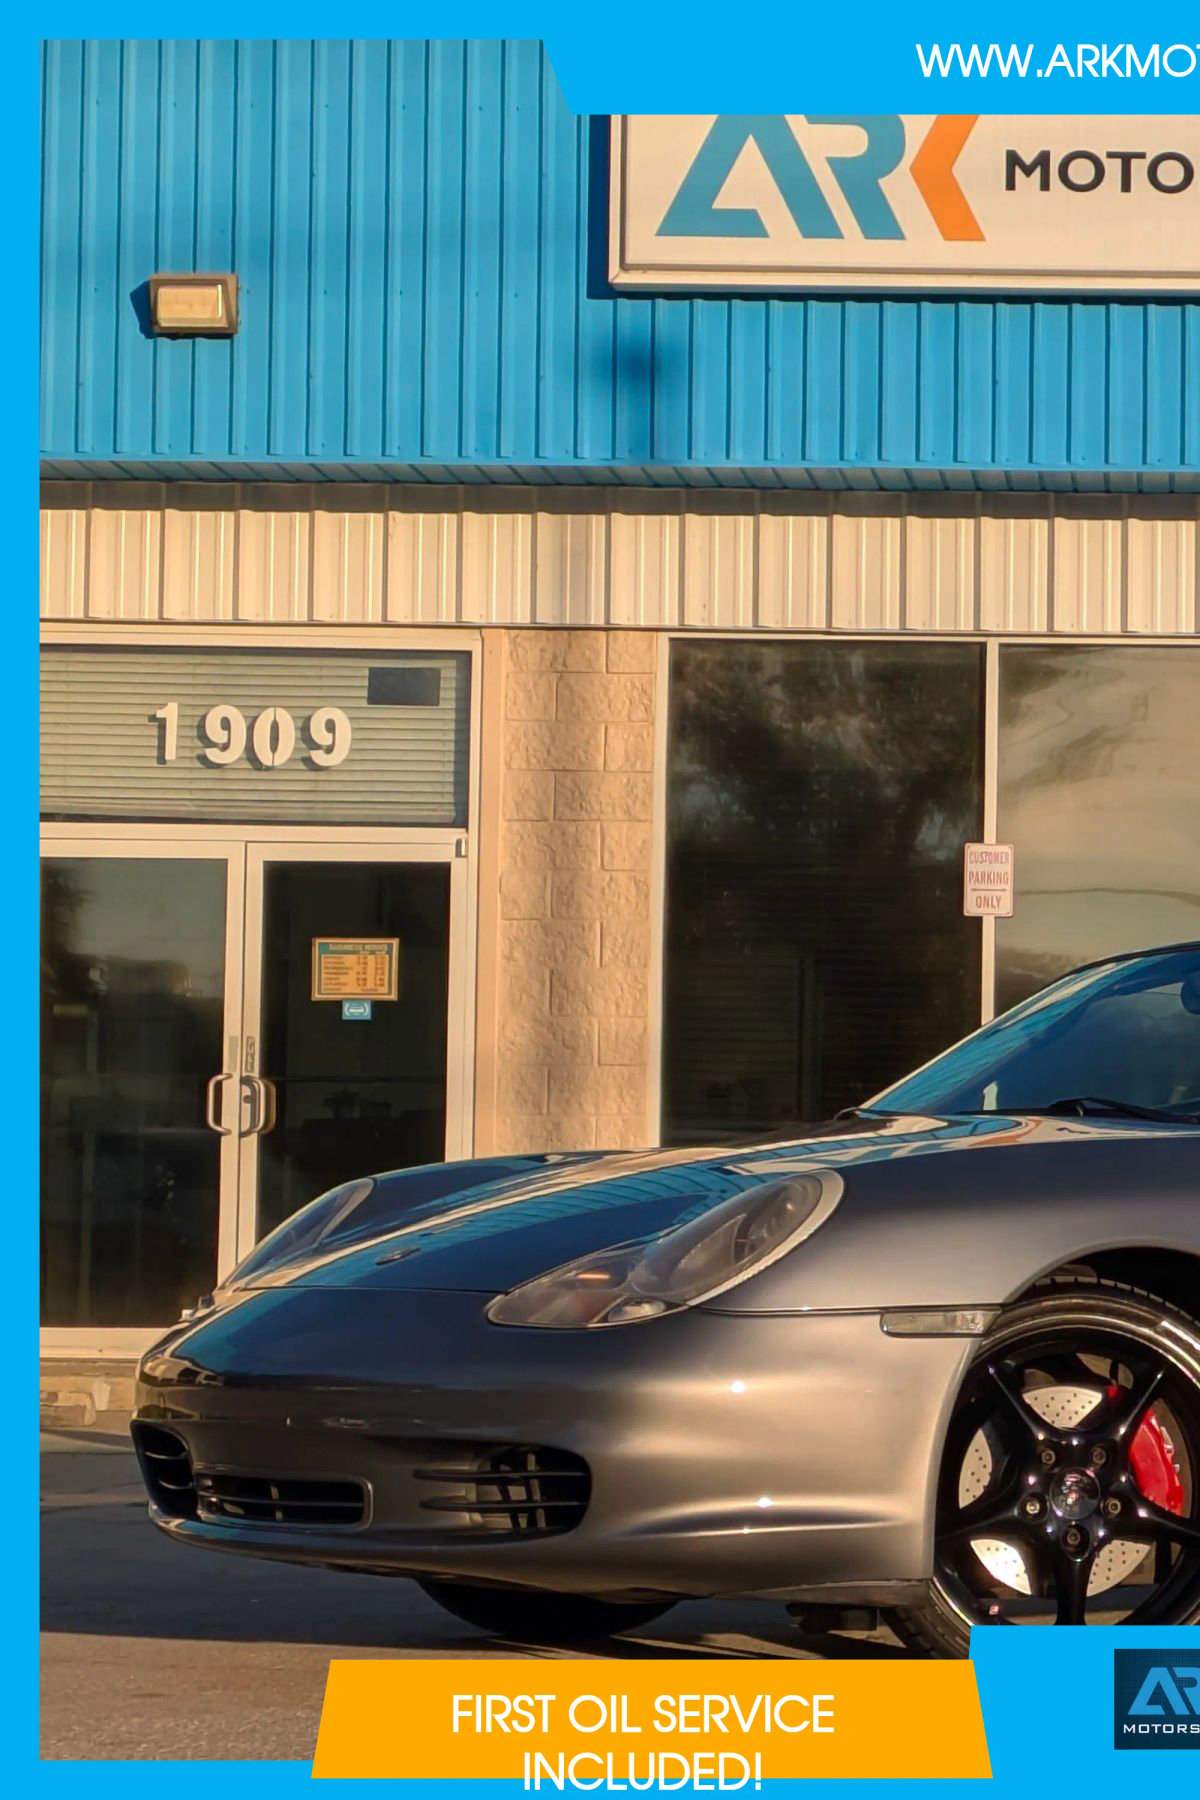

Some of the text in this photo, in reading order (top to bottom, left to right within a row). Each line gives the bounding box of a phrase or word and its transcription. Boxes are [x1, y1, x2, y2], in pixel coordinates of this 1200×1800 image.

[654, 114, 986, 242] ARK
[155, 701, 352, 767] 1909
[968, 851, 1009, 865] CUSTOMER
[968, 871, 1009, 886] PARKING
[975, 895, 1002, 909] ONLY
